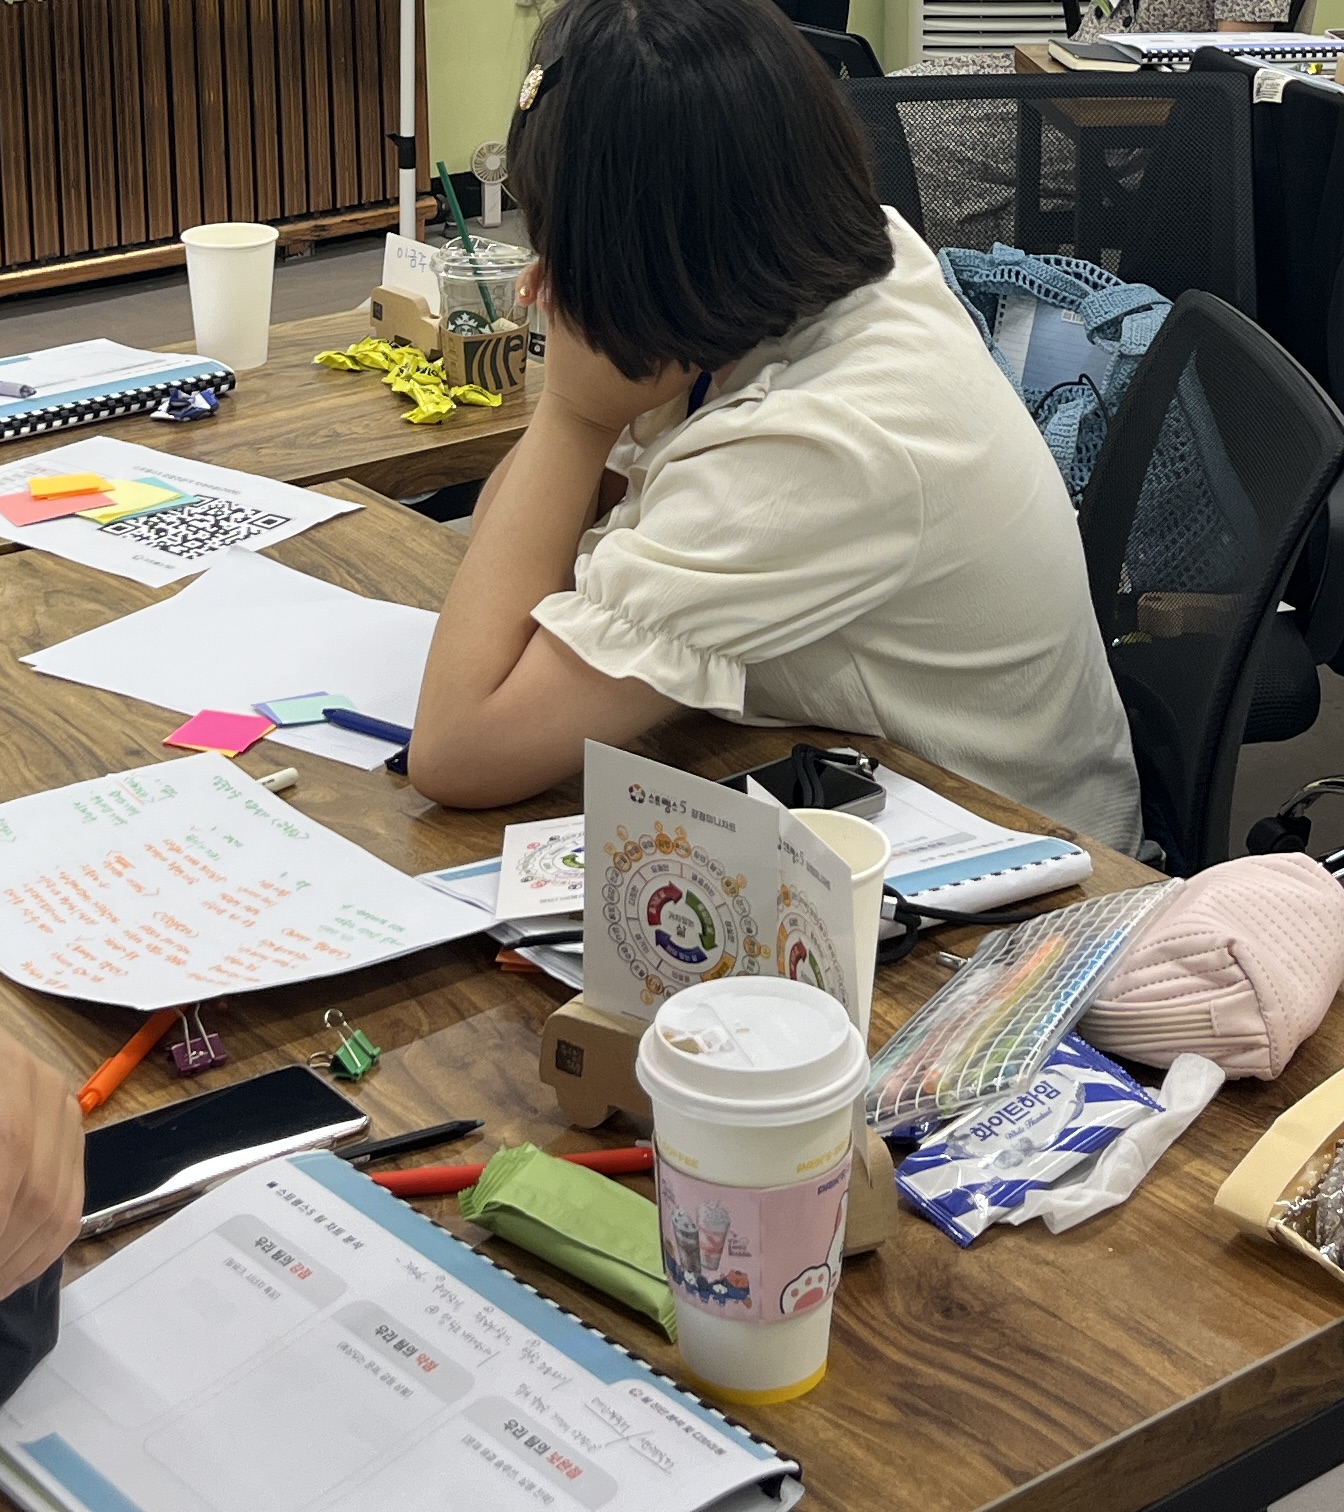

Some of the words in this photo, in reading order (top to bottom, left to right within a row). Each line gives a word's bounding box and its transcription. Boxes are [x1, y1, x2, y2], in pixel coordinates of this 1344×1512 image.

[397, 247, 427, 273] 이금주
[970, 1080, 1061, 1142] 화이트하임
[252, 1235, 274, 1253] 우리
[269, 1248, 295, 1267] 팀의
[287, 1261, 313, 1281] 강점
[372, 1324, 398, 1343] 우리
[391, 1338, 418, 1358] 팀의
[412, 1353, 439, 1373] 약점
[500, 1417, 530, 1439] 우리
[522, 1434, 551, 1455] 팀의
